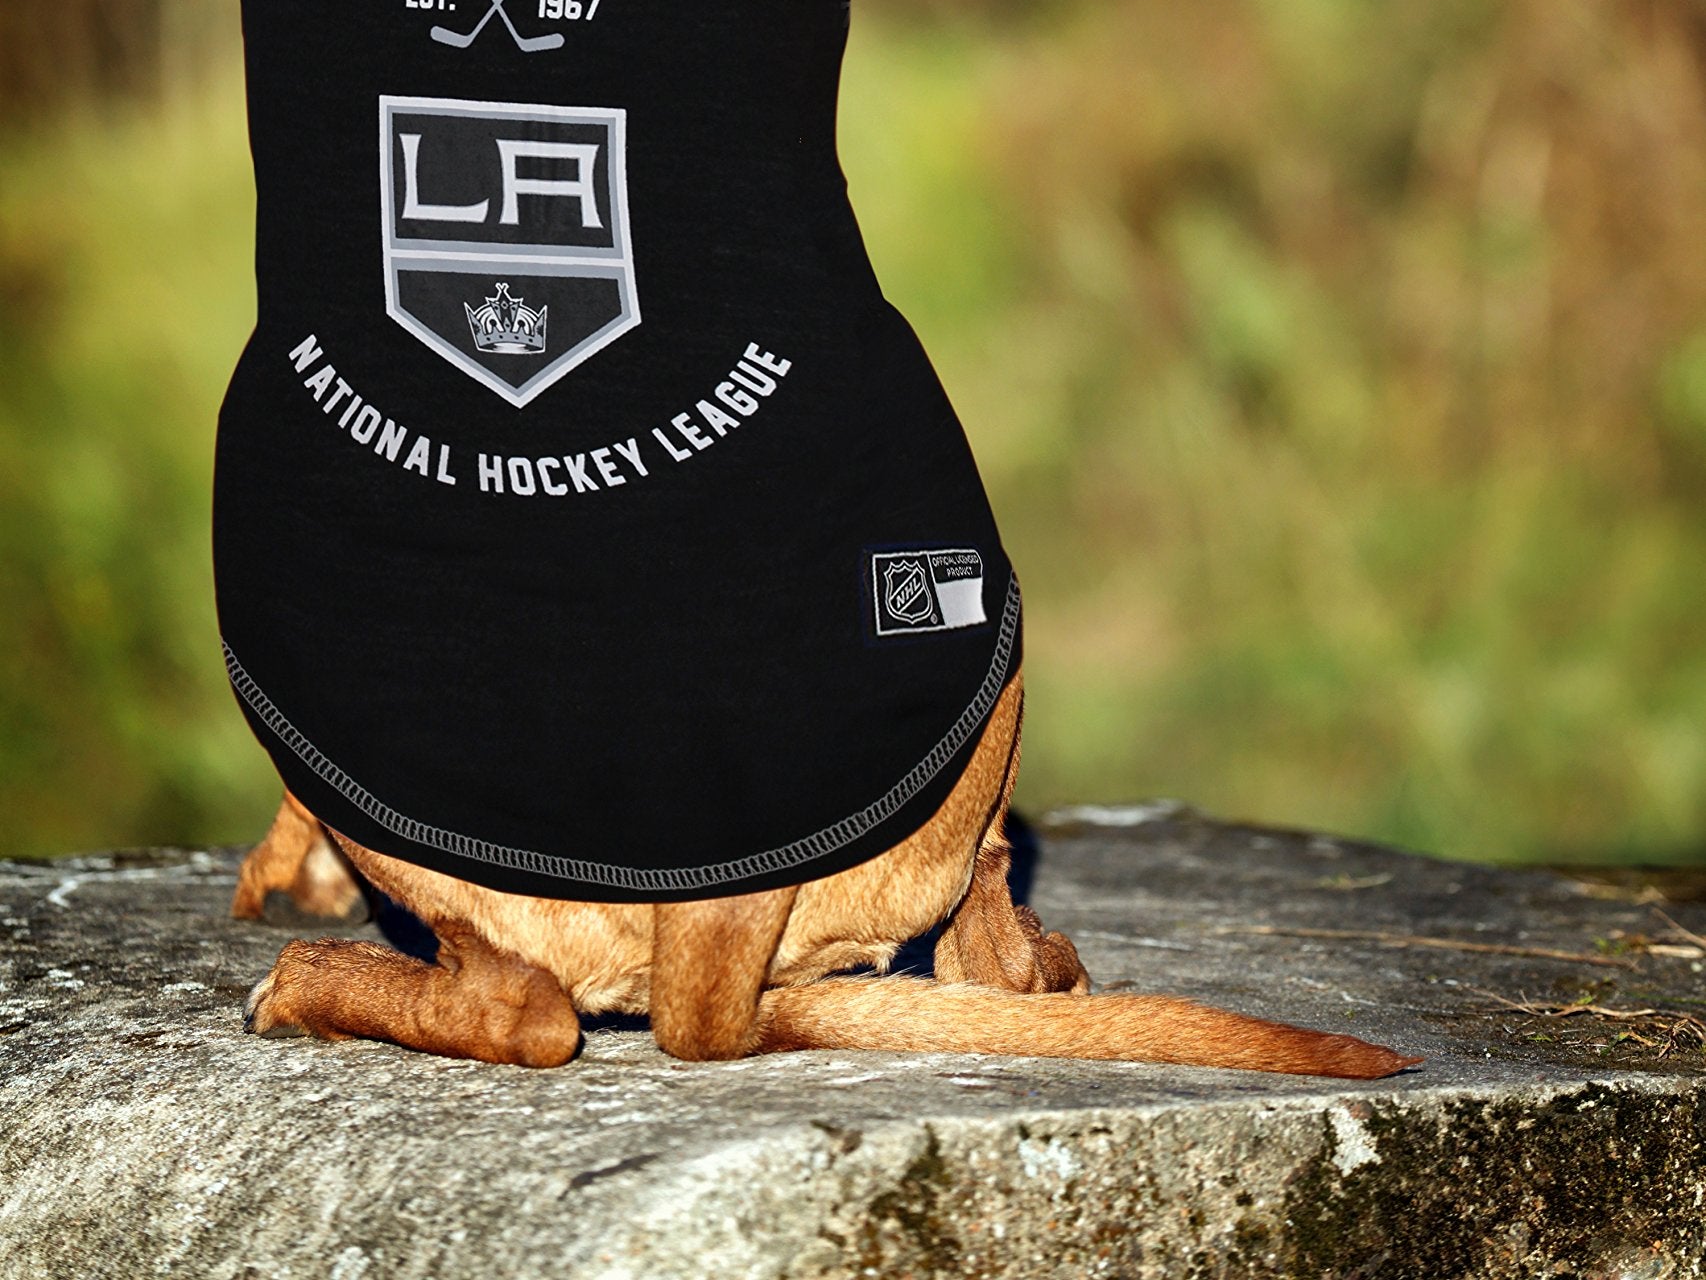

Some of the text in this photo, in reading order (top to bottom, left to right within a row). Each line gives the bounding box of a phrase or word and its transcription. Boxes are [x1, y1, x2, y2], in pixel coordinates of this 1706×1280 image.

[399, 133, 604, 229] LA
[288, 333, 792, 496] NATIONAL HOCKEY LEAGUE
[896, 577, 921, 608] NHL
